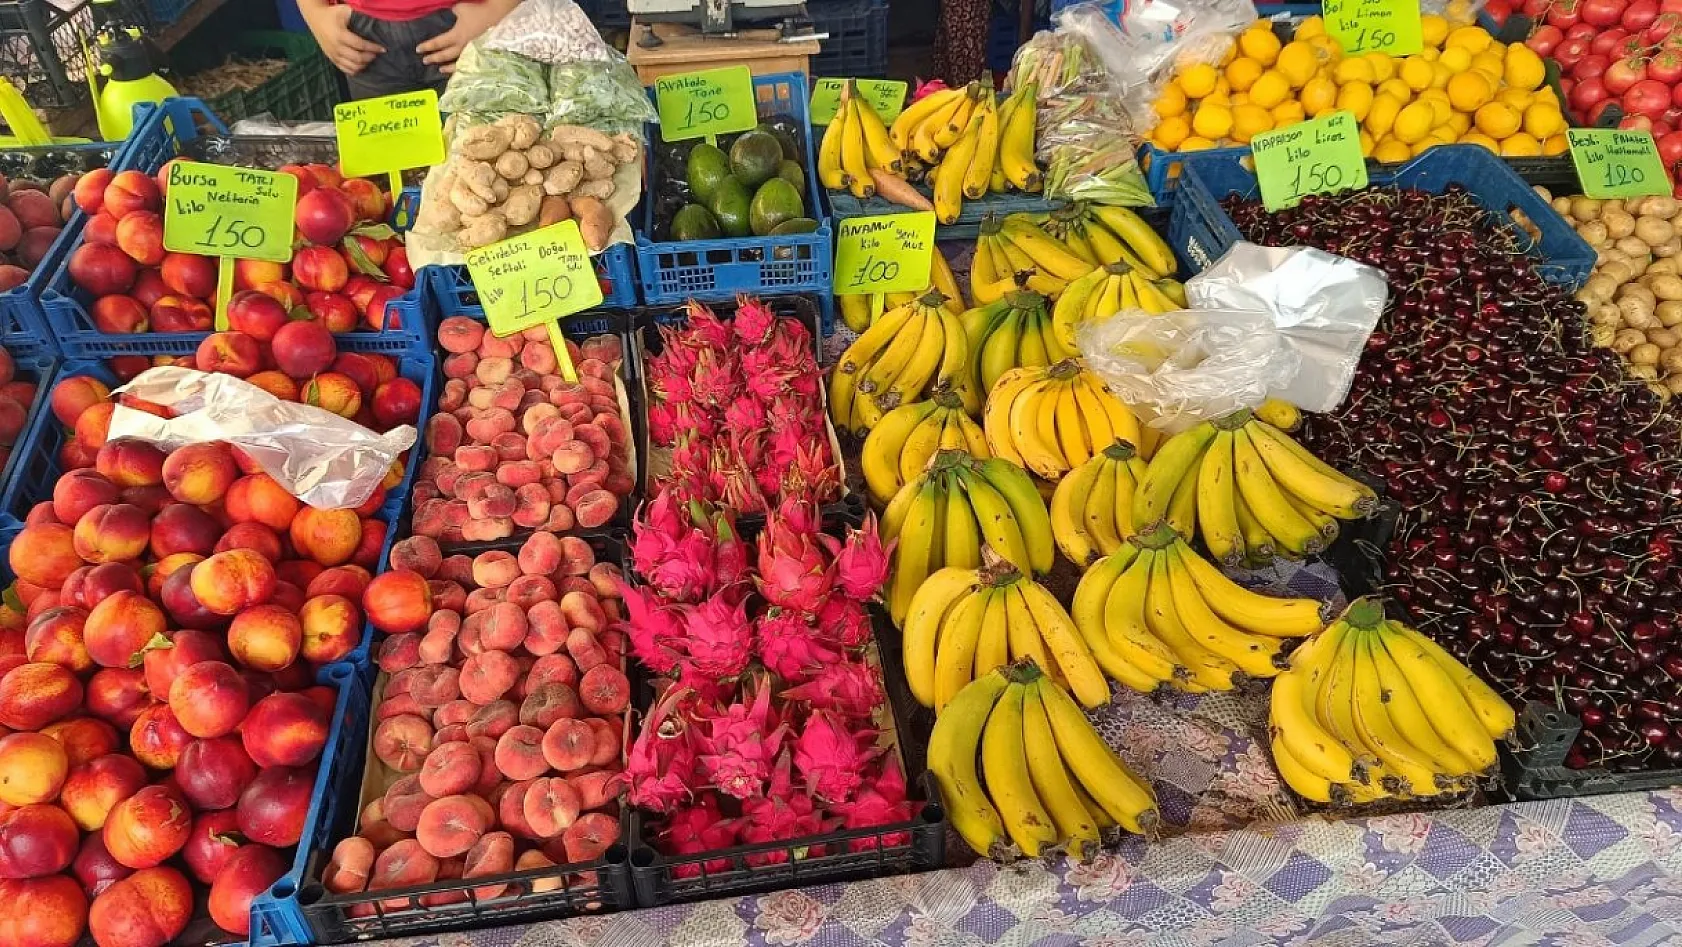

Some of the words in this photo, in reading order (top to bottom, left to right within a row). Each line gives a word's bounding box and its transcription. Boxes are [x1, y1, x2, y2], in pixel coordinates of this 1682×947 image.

[1357, 8, 1392, 18] Limon
[1347, 28, 1396, 53] 150
[677, 101, 730, 131] 150
[169, 163, 217, 186] Bursa
[1283, 163, 1342, 202] 150
[1603, 163, 1645, 187] 120
[195, 215, 265, 248] 150
[515, 275, 572, 320] 150
